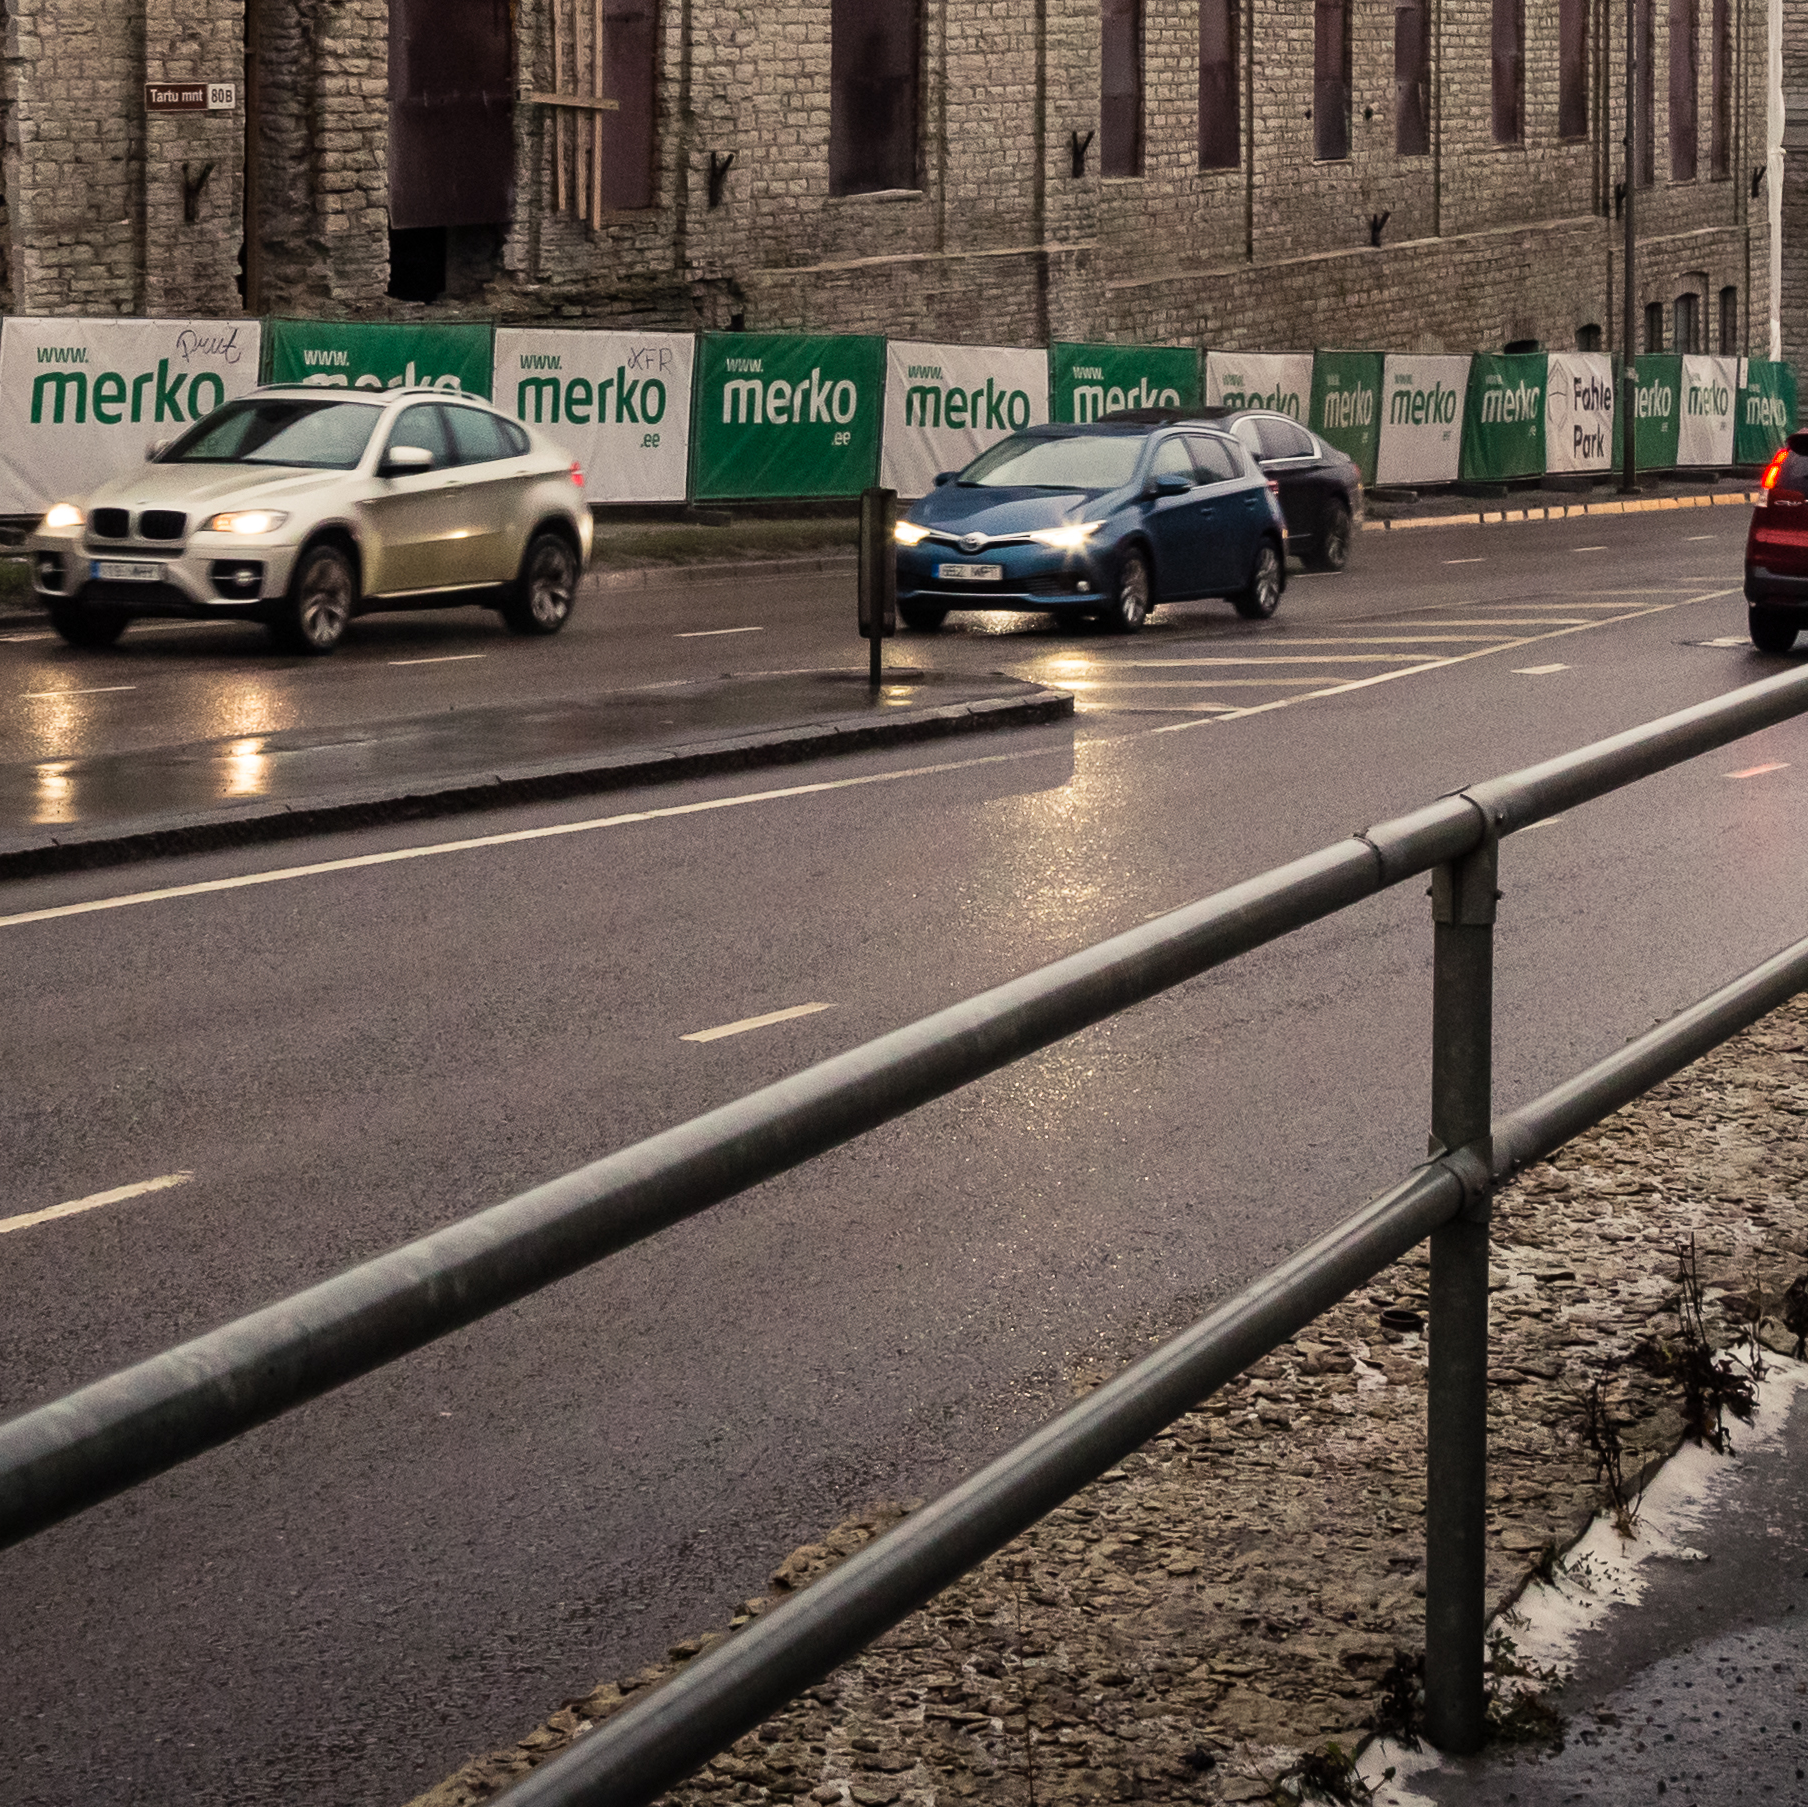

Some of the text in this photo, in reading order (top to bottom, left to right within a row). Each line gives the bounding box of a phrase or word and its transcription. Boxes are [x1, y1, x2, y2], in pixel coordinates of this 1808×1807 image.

[150, 88, 179, 103] Tartu
[181, 88, 203, 102] mnt
[37, 347, 90, 363] www.
[303, 349, 350, 366] www.
[519, 354, 563, 370] www.
[726, 357, 765, 372] www.
[908, 365, 944, 380] www.
[1072, 366, 1105, 380] www.
[30, 357, 226, 425] merko
[517, 366, 666, 425] merko
[723, 367, 857, 424] merko
[905, 377, 1031, 432] merko
[1323, 380, 1374, 429] merko
[1389, 381, 1457, 426] merko
[1480, 379, 1541, 424] merko
[1573, 375, 1613, 411] Fahle
[1634, 378, 1672, 418] erko
[639, 433, 661, 449] .ee
[831, 430, 852, 446] .ee
[1573, 424, 1605, 459] Park
